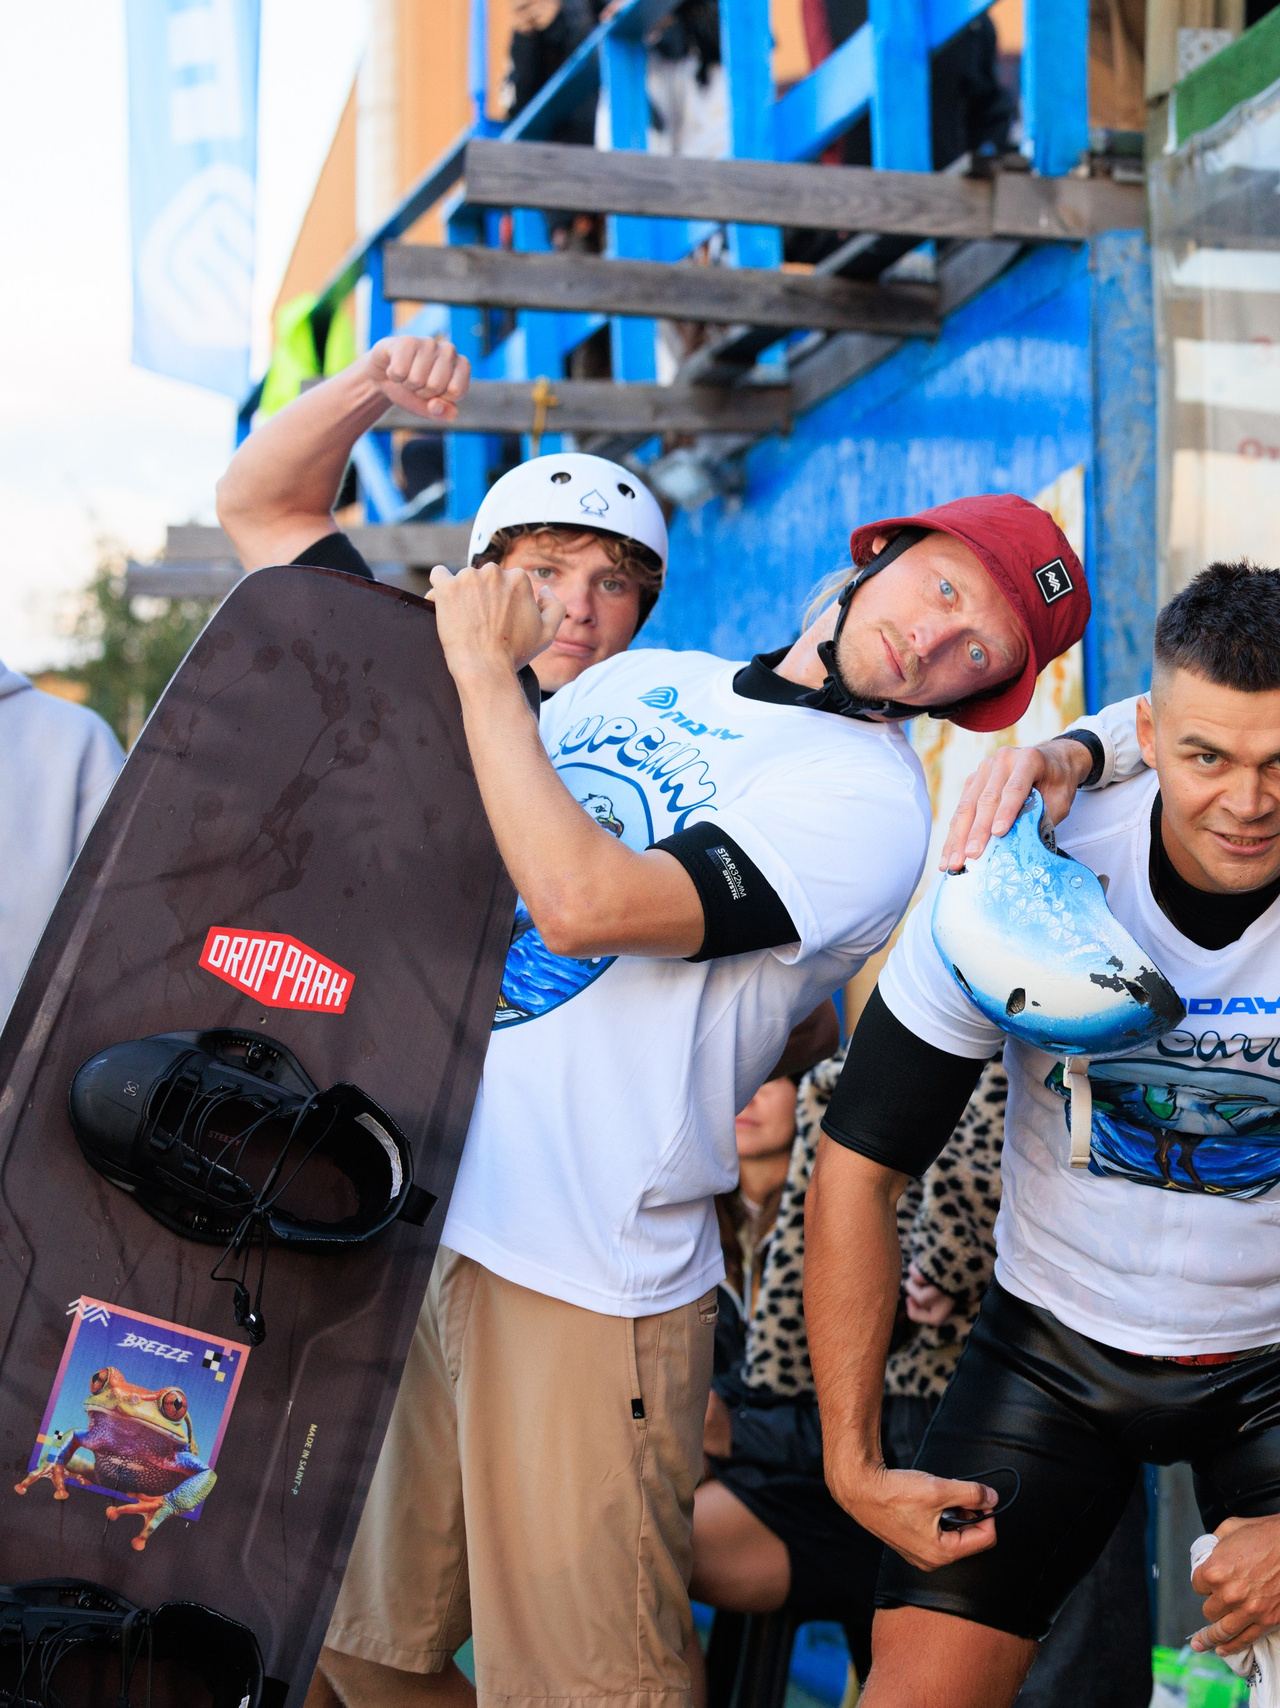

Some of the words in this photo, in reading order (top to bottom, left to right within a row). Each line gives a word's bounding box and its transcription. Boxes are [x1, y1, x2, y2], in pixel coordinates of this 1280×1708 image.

[116, 1332, 194, 1363] BREEZE
[305, 1423, 318, 1449] MADE
[301, 1449, 310, 1459] IN
